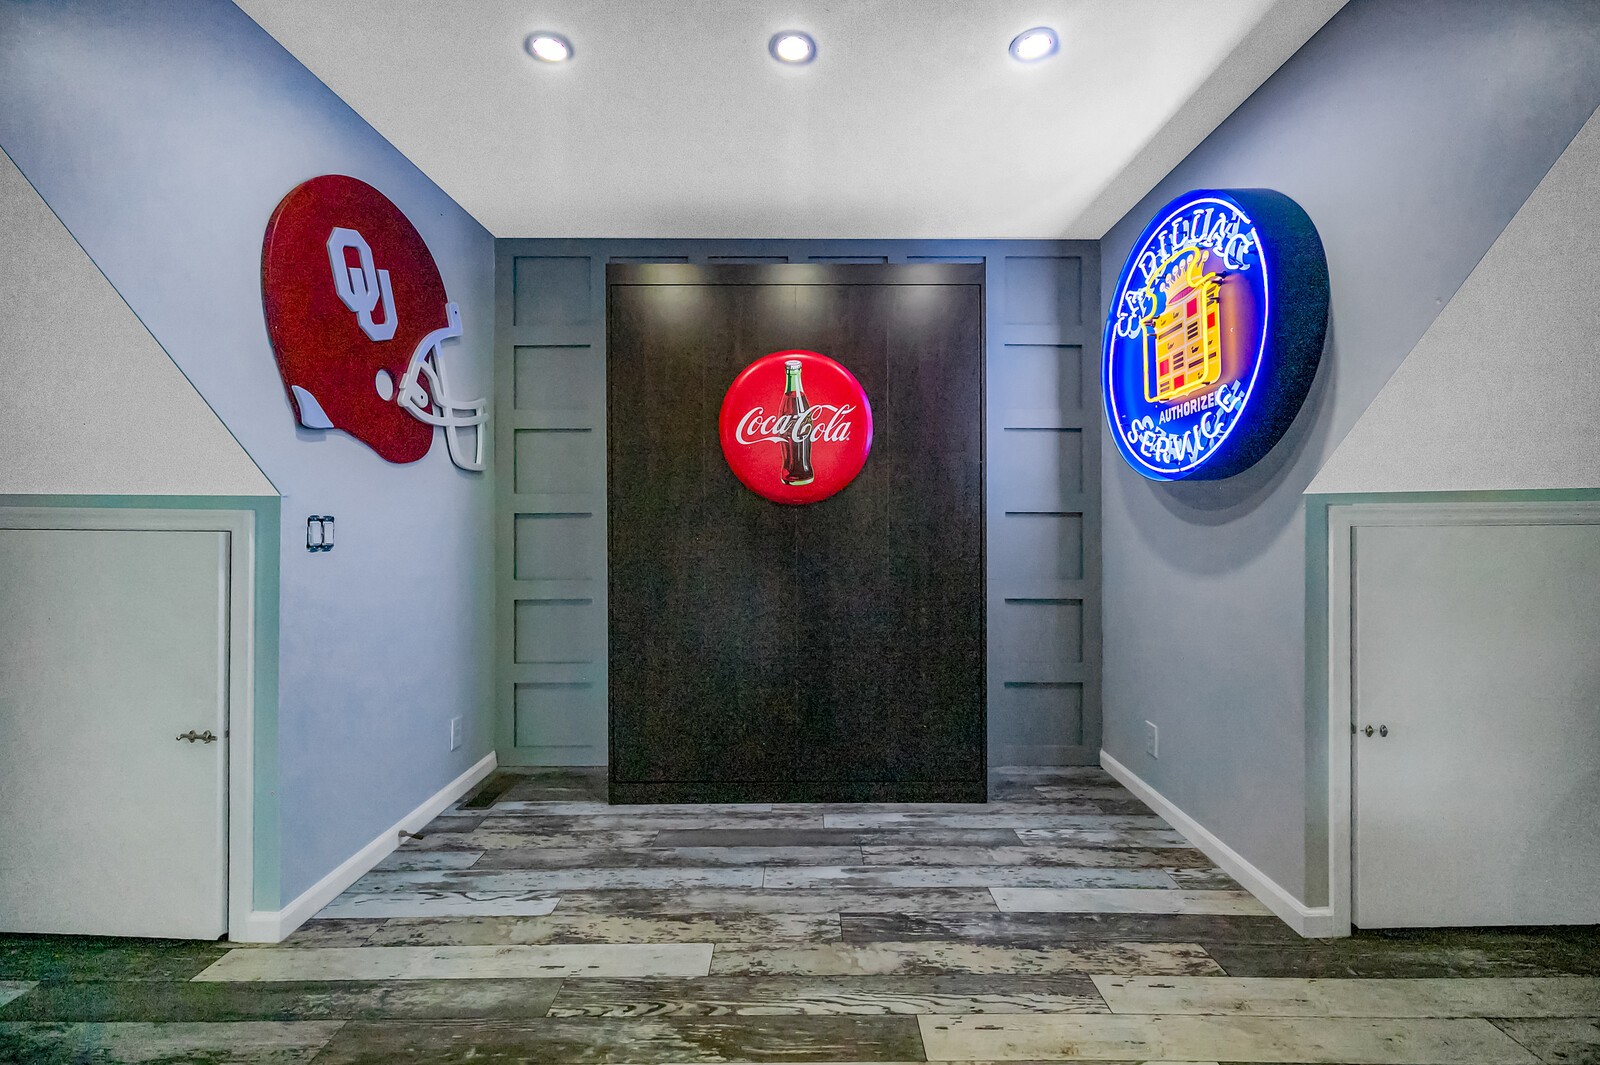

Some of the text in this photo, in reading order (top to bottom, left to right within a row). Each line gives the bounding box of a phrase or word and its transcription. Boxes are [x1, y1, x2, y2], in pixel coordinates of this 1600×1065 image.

[326, 227, 398, 341] OU
[736, 404, 856, 445] Coca-Cola
[1127, 383, 1243, 464] SERVICE
